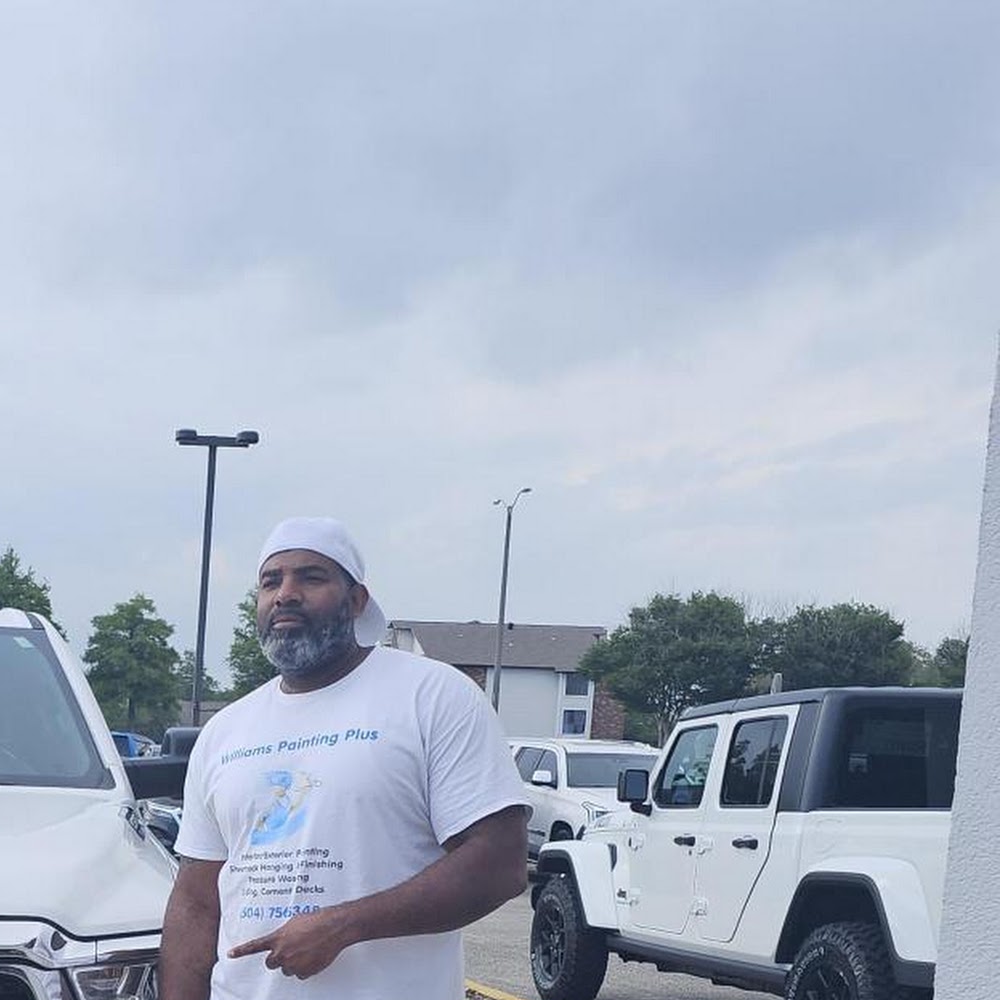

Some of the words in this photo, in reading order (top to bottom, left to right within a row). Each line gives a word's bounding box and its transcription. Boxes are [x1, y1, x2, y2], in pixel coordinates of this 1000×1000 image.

[221, 744, 273, 765] Williams
[277, 733, 339, 752] Painting
[344, 728, 379, 741] Plus
[295, 885, 326, 894] Decks
